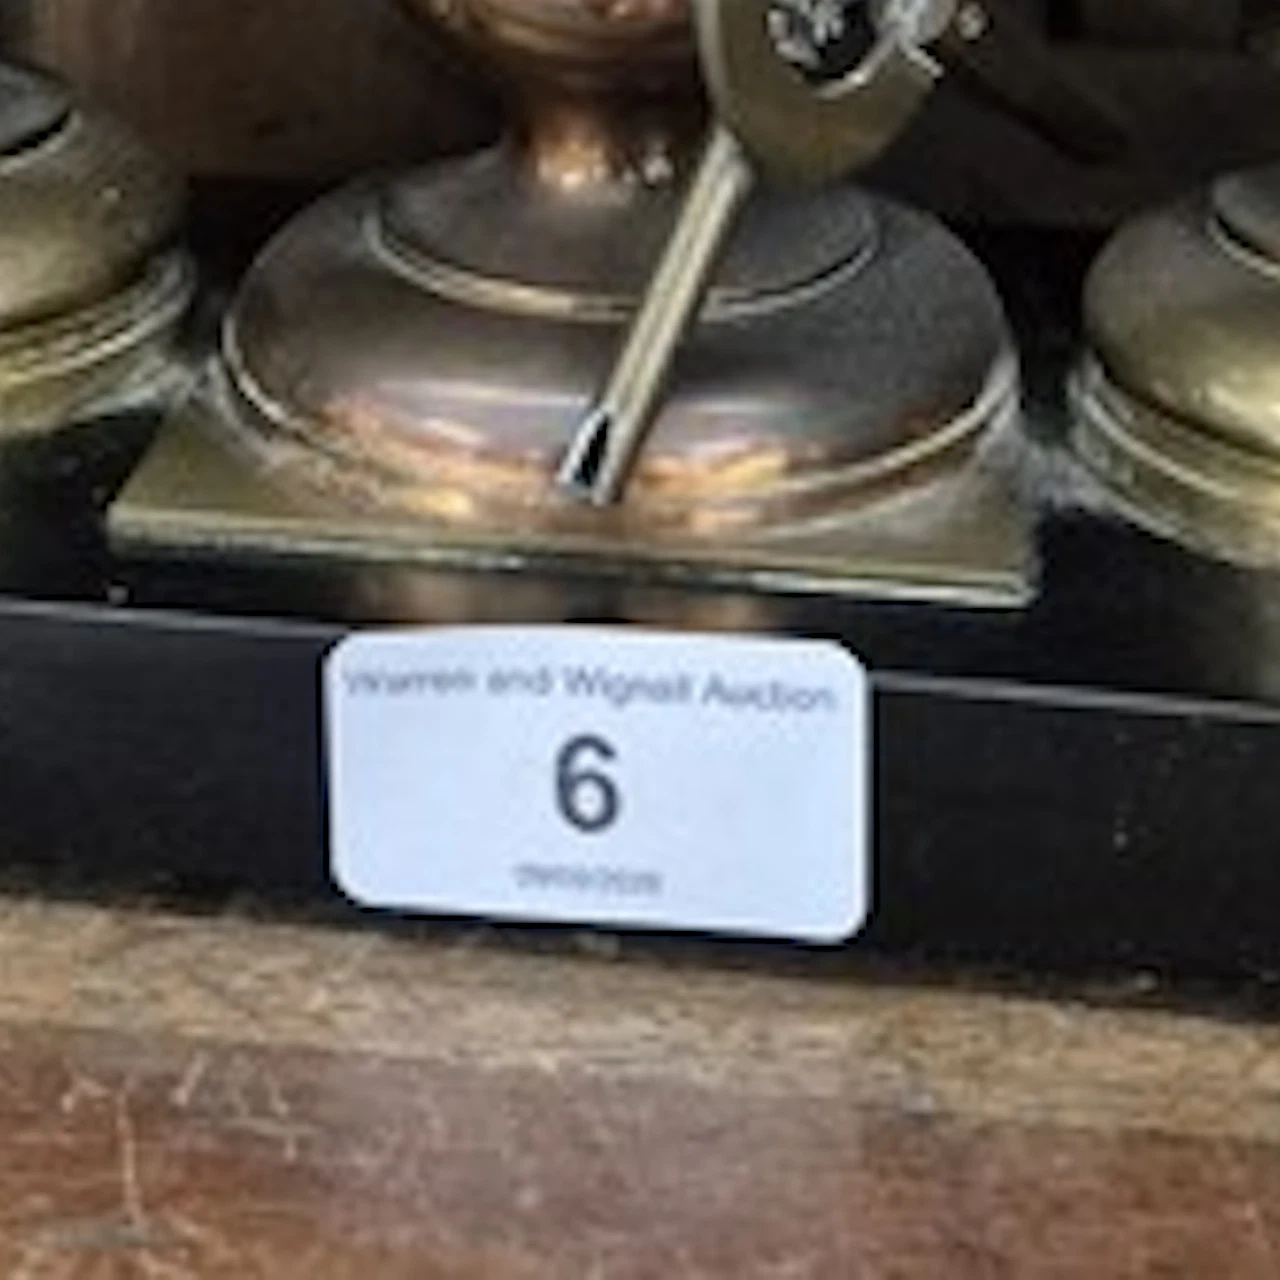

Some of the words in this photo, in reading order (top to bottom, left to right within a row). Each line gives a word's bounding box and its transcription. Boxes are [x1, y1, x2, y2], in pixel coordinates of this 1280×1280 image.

[486, 665, 555, 698] and
[699, 671, 839, 714] Auction
[554, 733, 624, 833] 6
